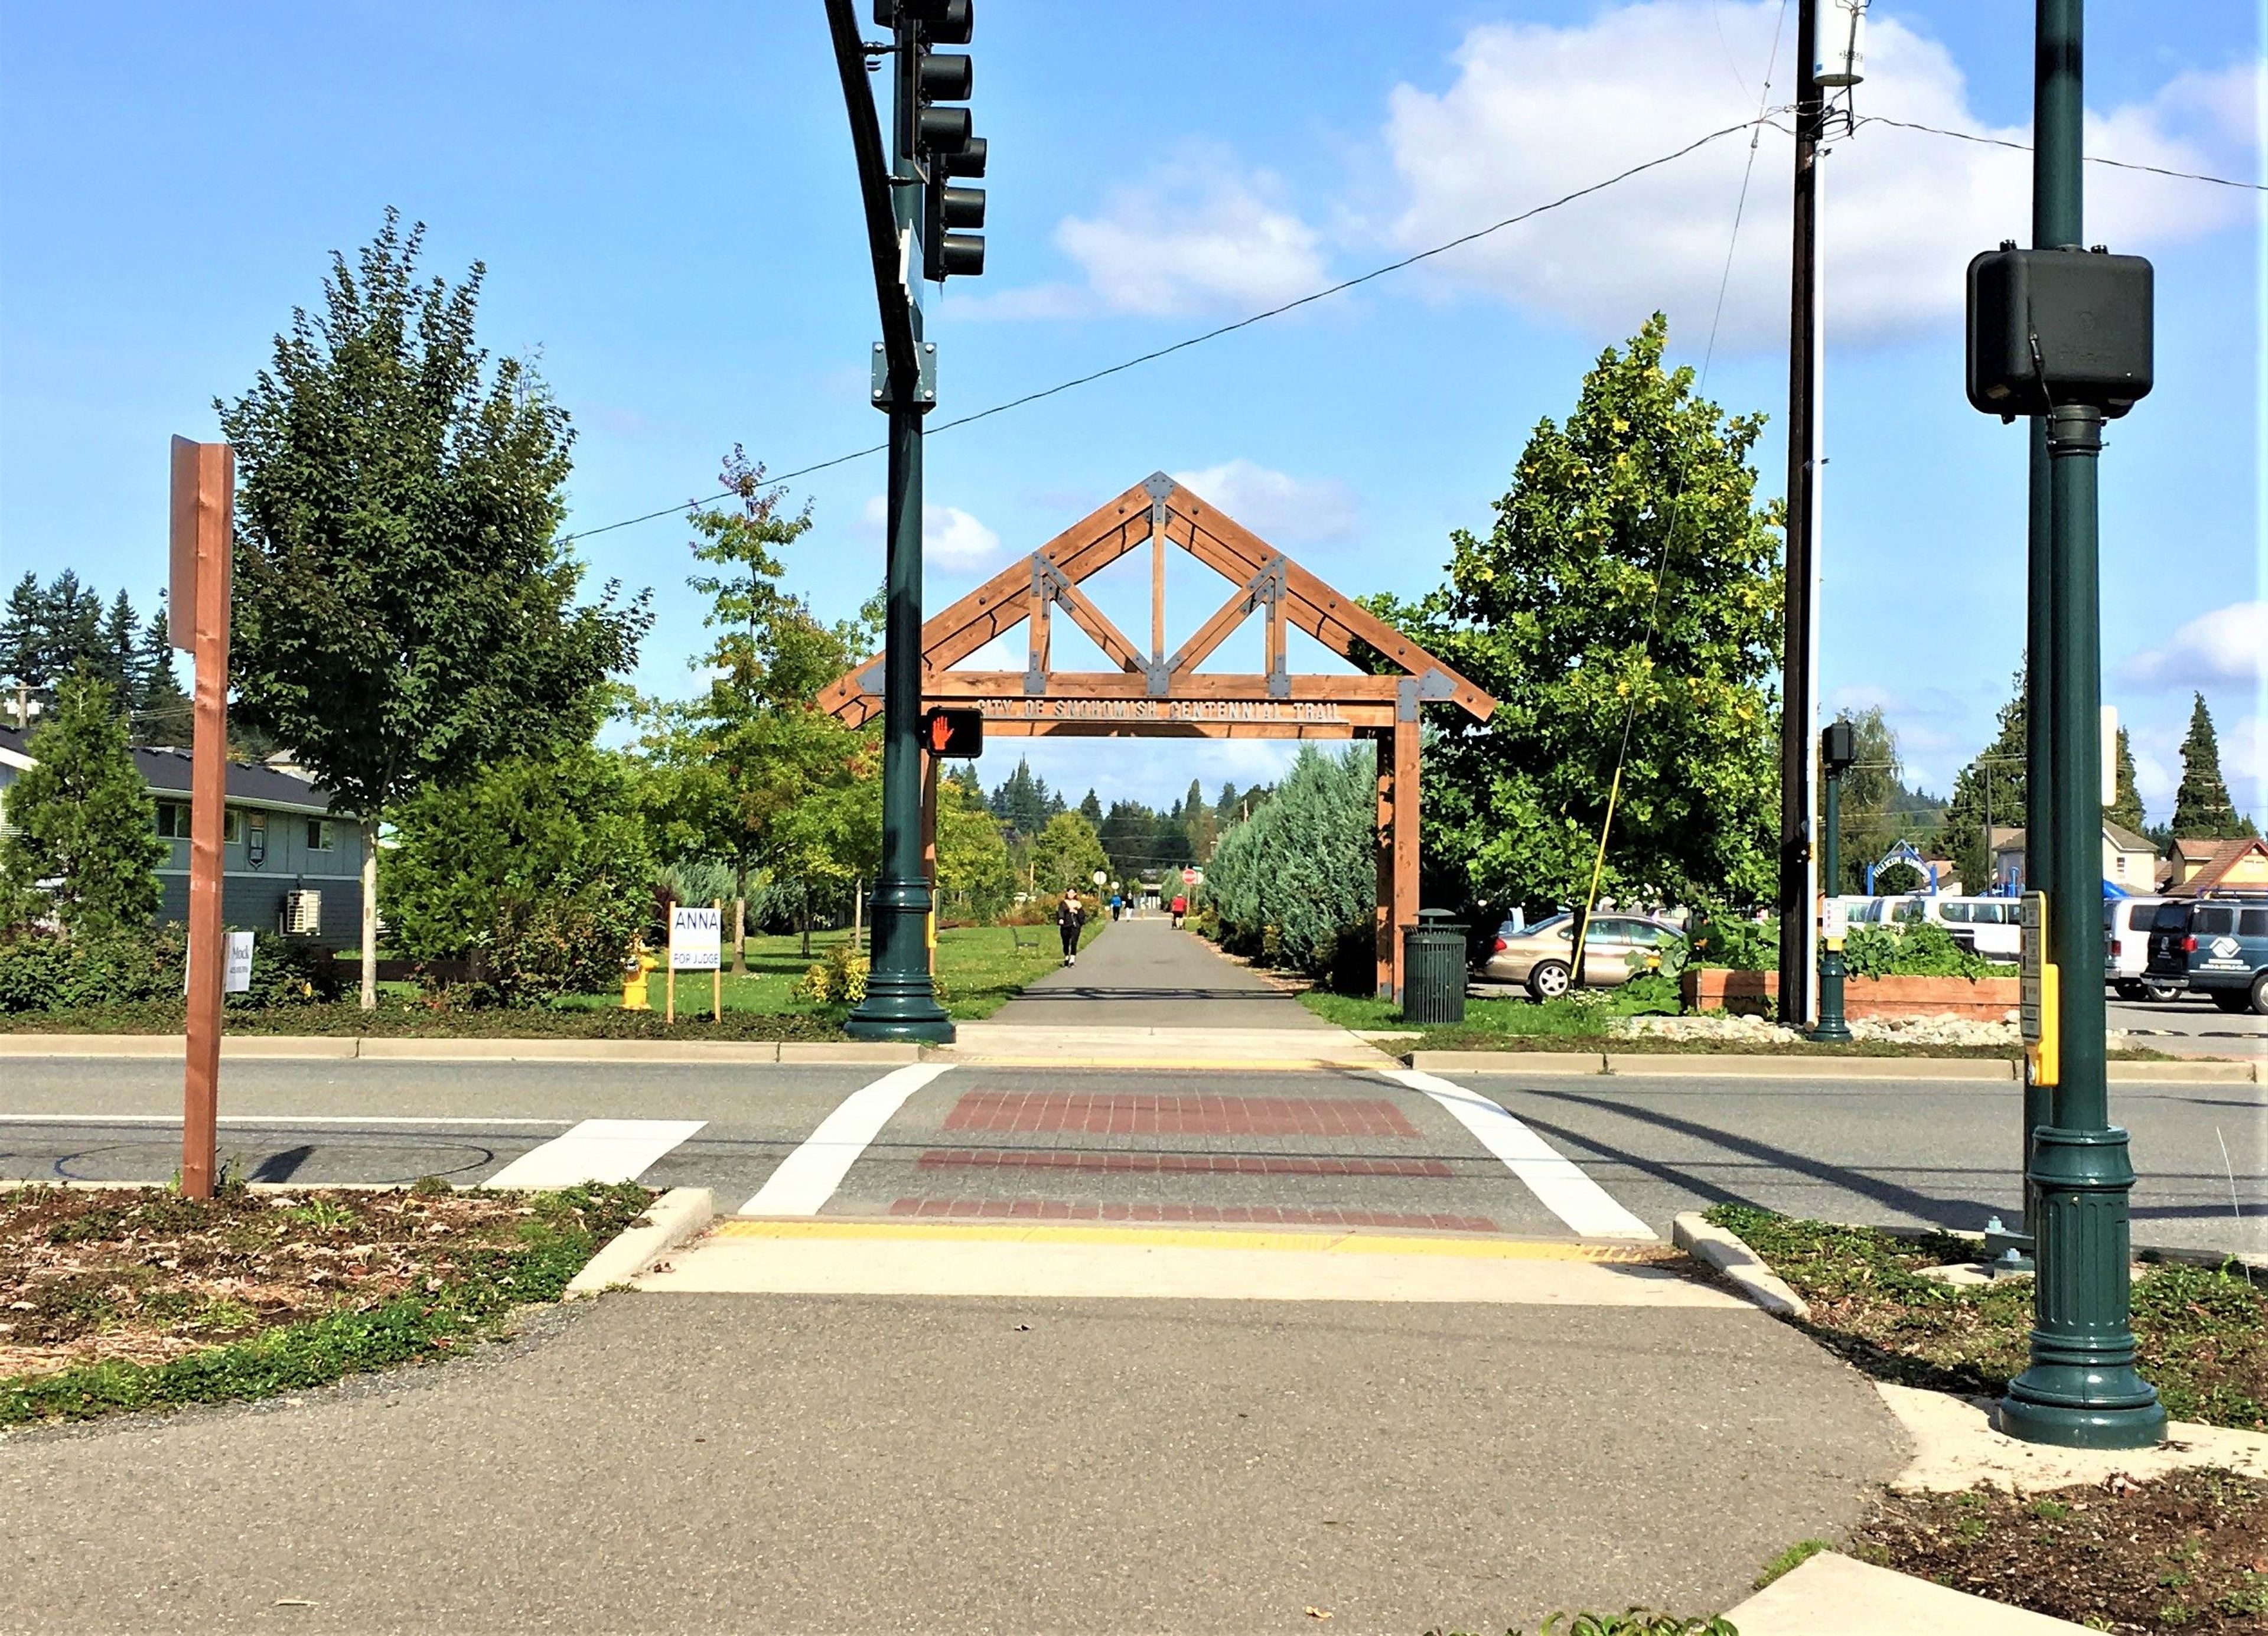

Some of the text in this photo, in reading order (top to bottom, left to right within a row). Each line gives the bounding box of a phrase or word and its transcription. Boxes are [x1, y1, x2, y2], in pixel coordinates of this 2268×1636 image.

[977, 699, 1340, 721] CITY OF SNOHOMISH CENTENNIAL TRAIL
[674, 911, 719, 930] ANNA
[674, 953, 719, 964] FOR JUDGE
